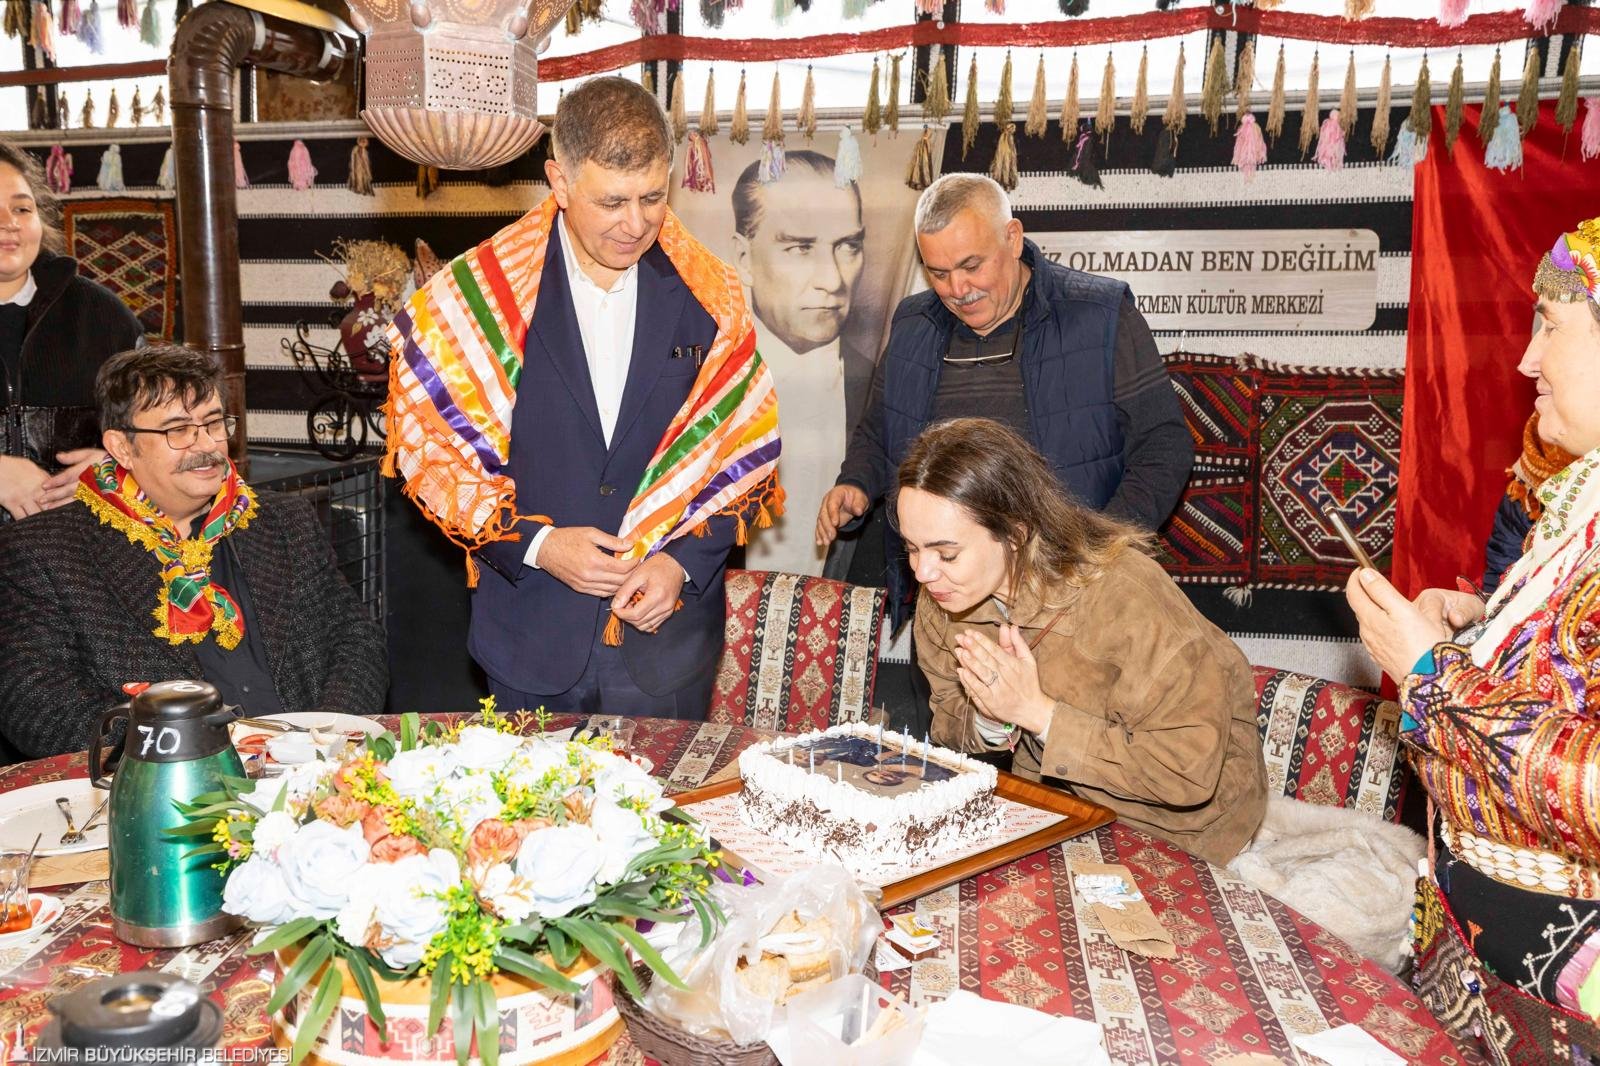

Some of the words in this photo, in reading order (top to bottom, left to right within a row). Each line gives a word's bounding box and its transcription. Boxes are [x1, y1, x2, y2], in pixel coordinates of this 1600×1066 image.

[1069, 250, 1194, 272] OLMADAN
[1200, 250, 1252, 272] BEN
[1261, 243, 1377, 272] DEĞİLİM
[1136, 294, 1183, 314] KMEN
[1186, 289, 1248, 314] KÜLTÜR
[1251, 289, 1324, 314] MERKEZİ
[137, 724, 181, 758] 70
